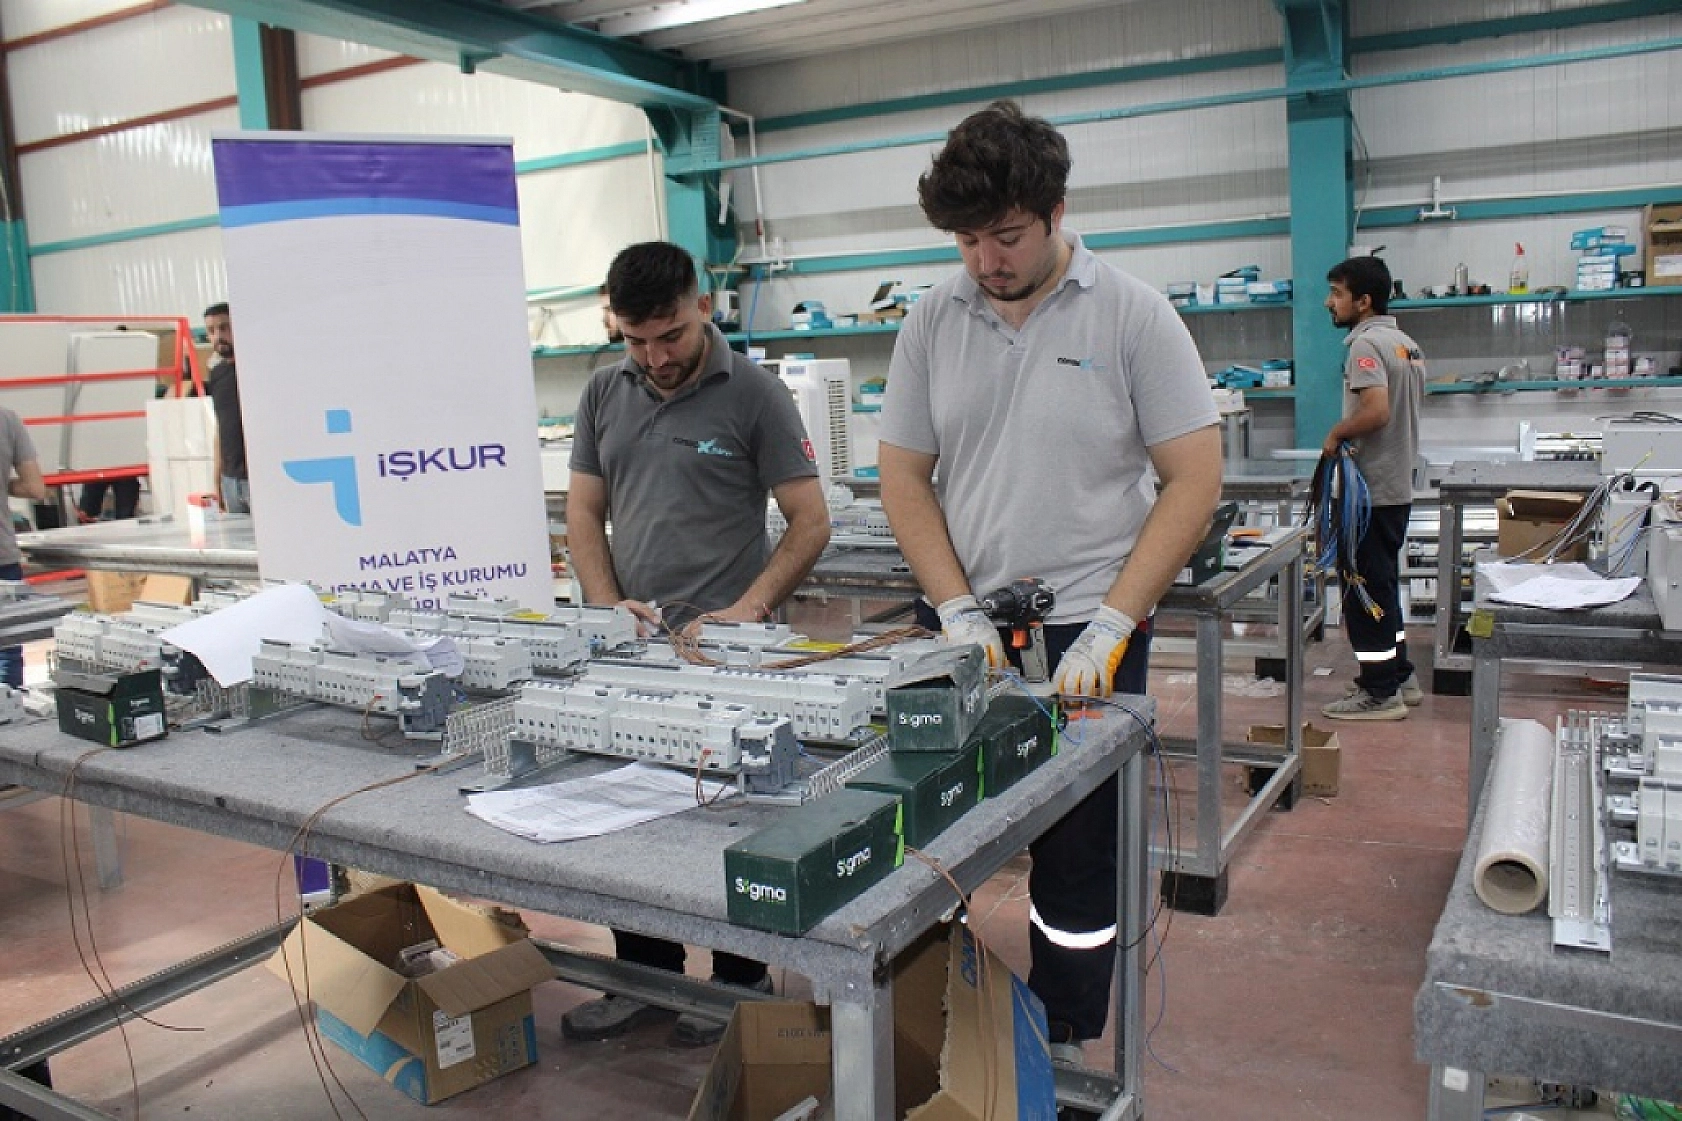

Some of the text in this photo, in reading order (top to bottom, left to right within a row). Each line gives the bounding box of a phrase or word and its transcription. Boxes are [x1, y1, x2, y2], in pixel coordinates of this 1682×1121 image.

[359, 546, 457, 570] MALATYA
[387, 577, 414, 592] VE
[419, 571, 438, 593] İŞ
[442, 563, 528, 586] KURUMU
[734, 876, 787, 903] Sigma
